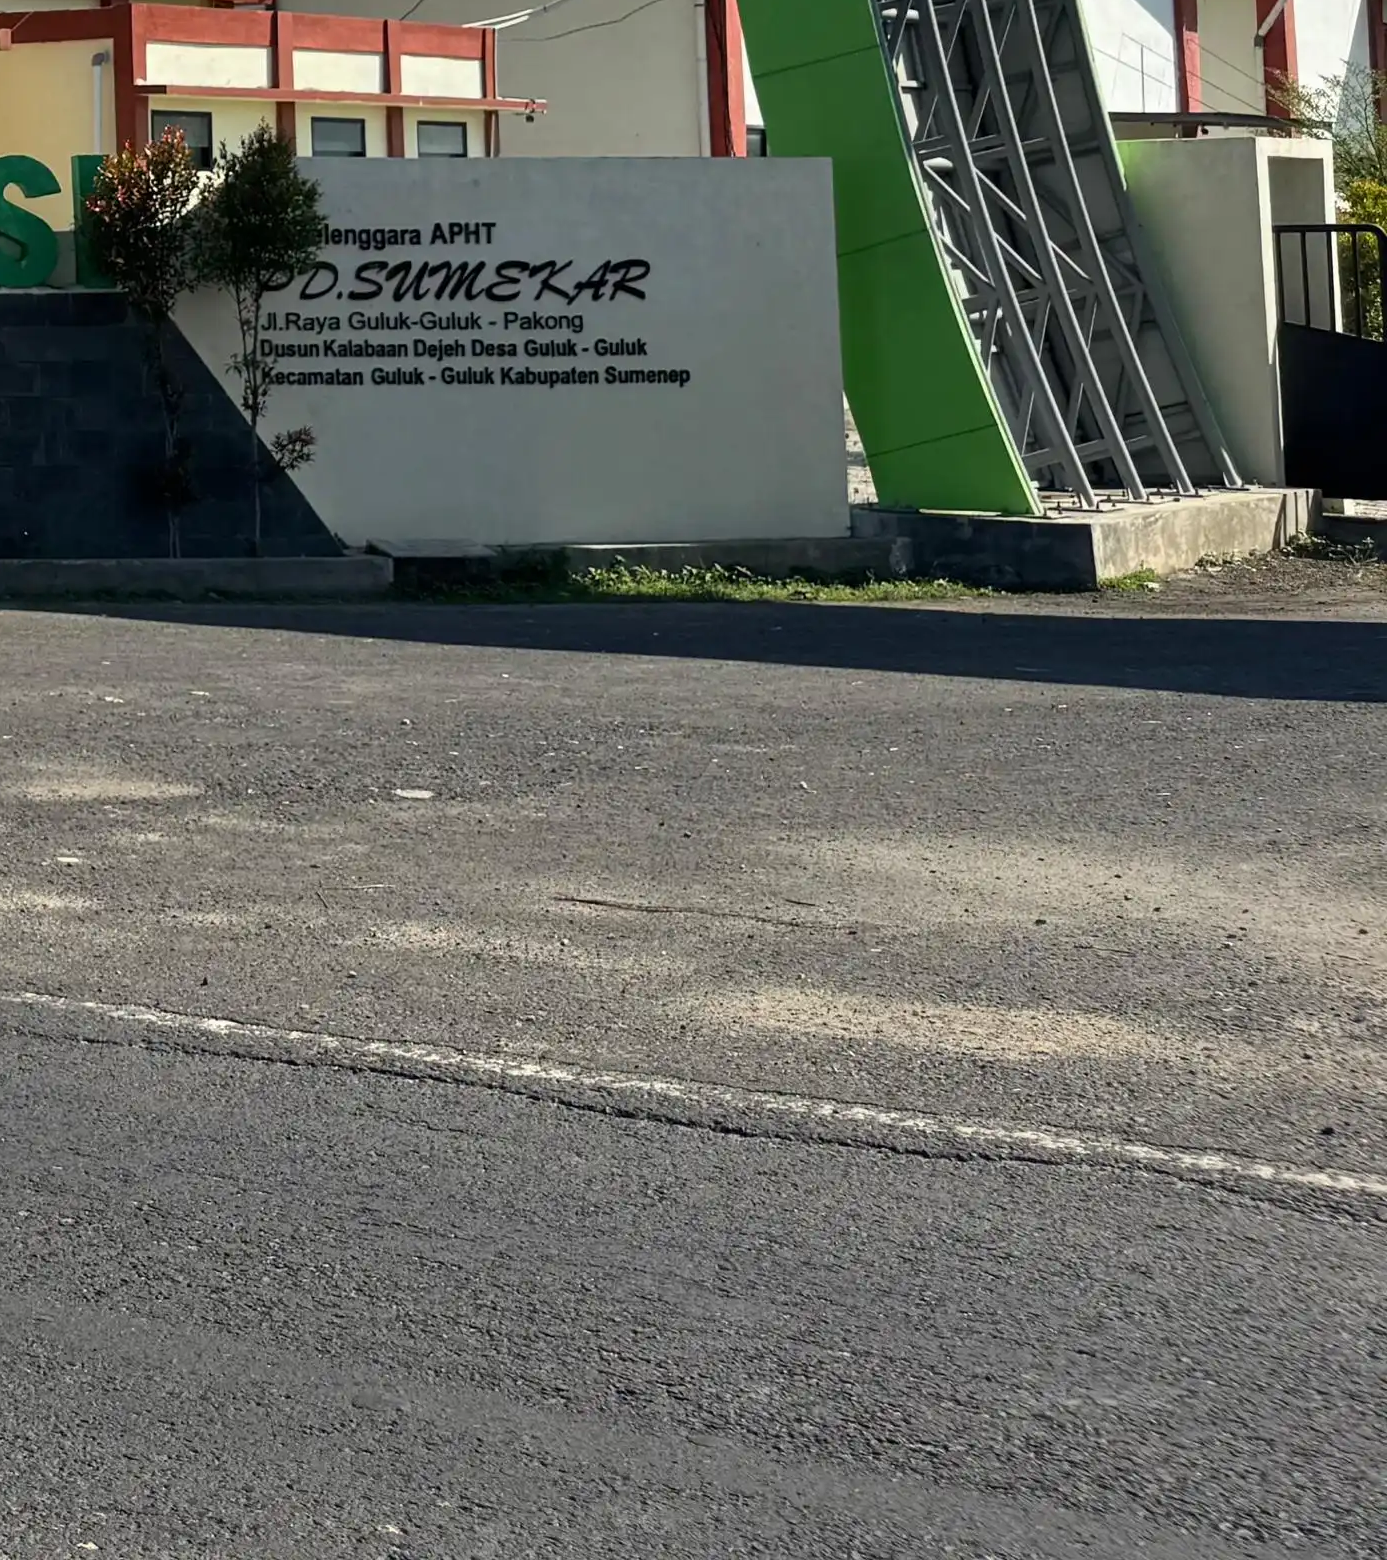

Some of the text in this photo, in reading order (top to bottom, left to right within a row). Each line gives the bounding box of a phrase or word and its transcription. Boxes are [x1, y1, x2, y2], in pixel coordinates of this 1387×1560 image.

[318, 222, 497, 252] lenggara APHT
[348, 311, 483, 331] Guluk-Guluk
[503, 311, 584, 333] Pakong
[260, 339, 320, 358] Dusun
[324, 339, 409, 358] Kalabaan
[413, 339, 466, 362] Dejeh
[471, 339, 517, 357] Desa
[523, 338, 578, 358] Guluk
[594, 338, 648, 357] Guluk
[261, 367, 364, 386] Kecamatan
[370, 366, 425, 386] Guluk
[440, 366, 495, 385] Guluk
[499, 366, 600, 388] Kabupaten
[604, 365, 691, 388] Sumenep
